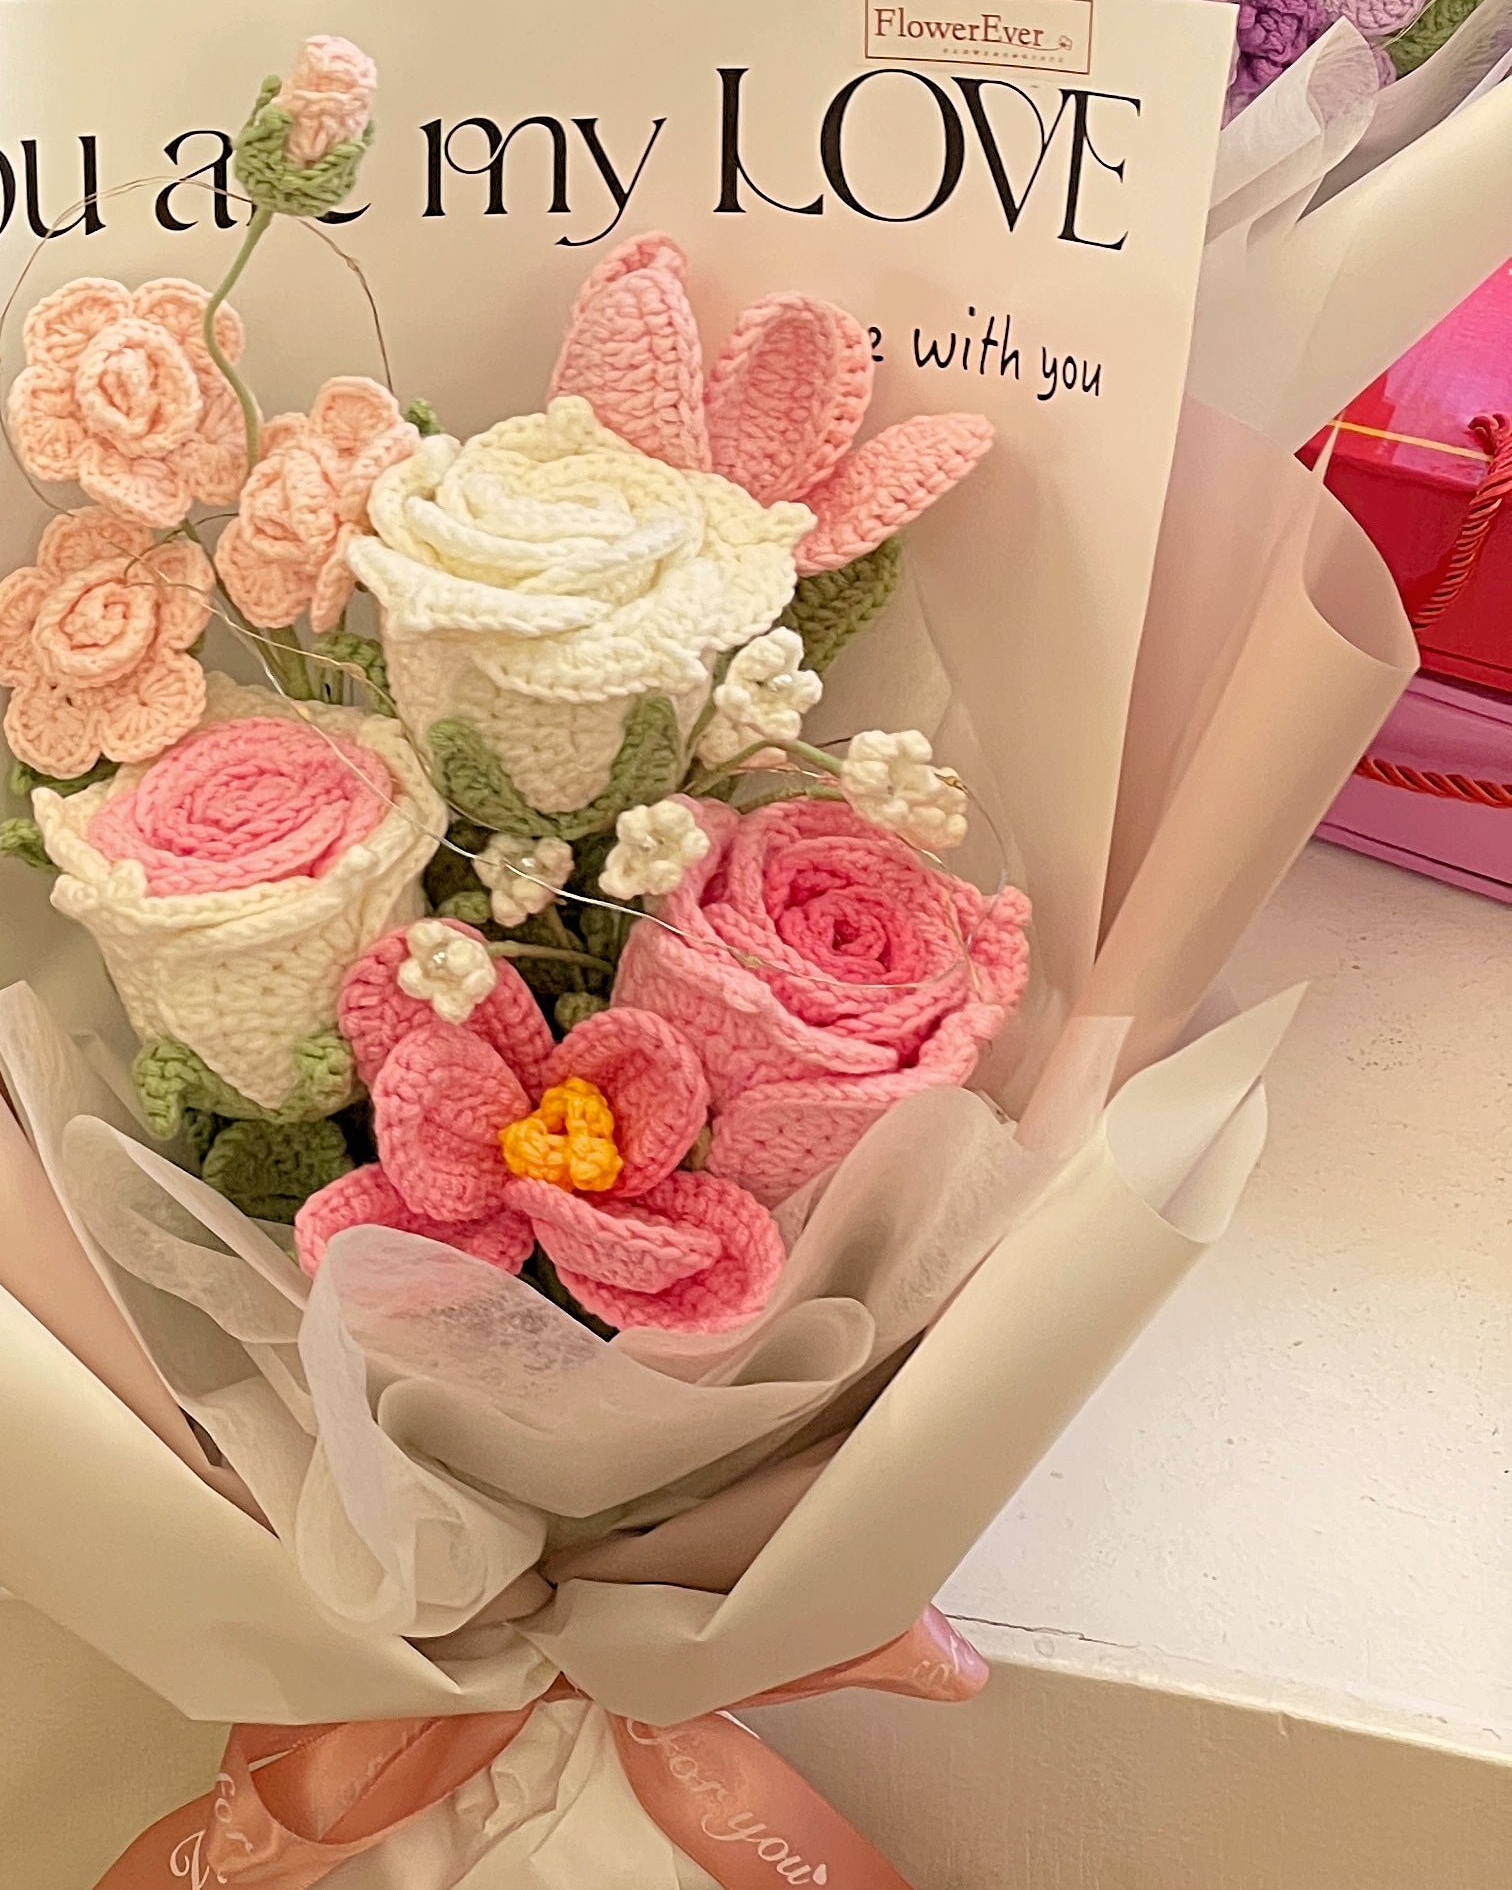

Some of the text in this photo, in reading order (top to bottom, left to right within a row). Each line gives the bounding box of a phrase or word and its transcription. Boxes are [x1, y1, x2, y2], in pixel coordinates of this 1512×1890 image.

[873, 7, 1044, 47] FlowerEver
[420, 114, 666, 247] my
[713, 66, 1142, 252] LOVE
[913, 306, 1020, 380] with
[1037, 346, 1102, 401] you
[700, 1812, 812, 1886] you
